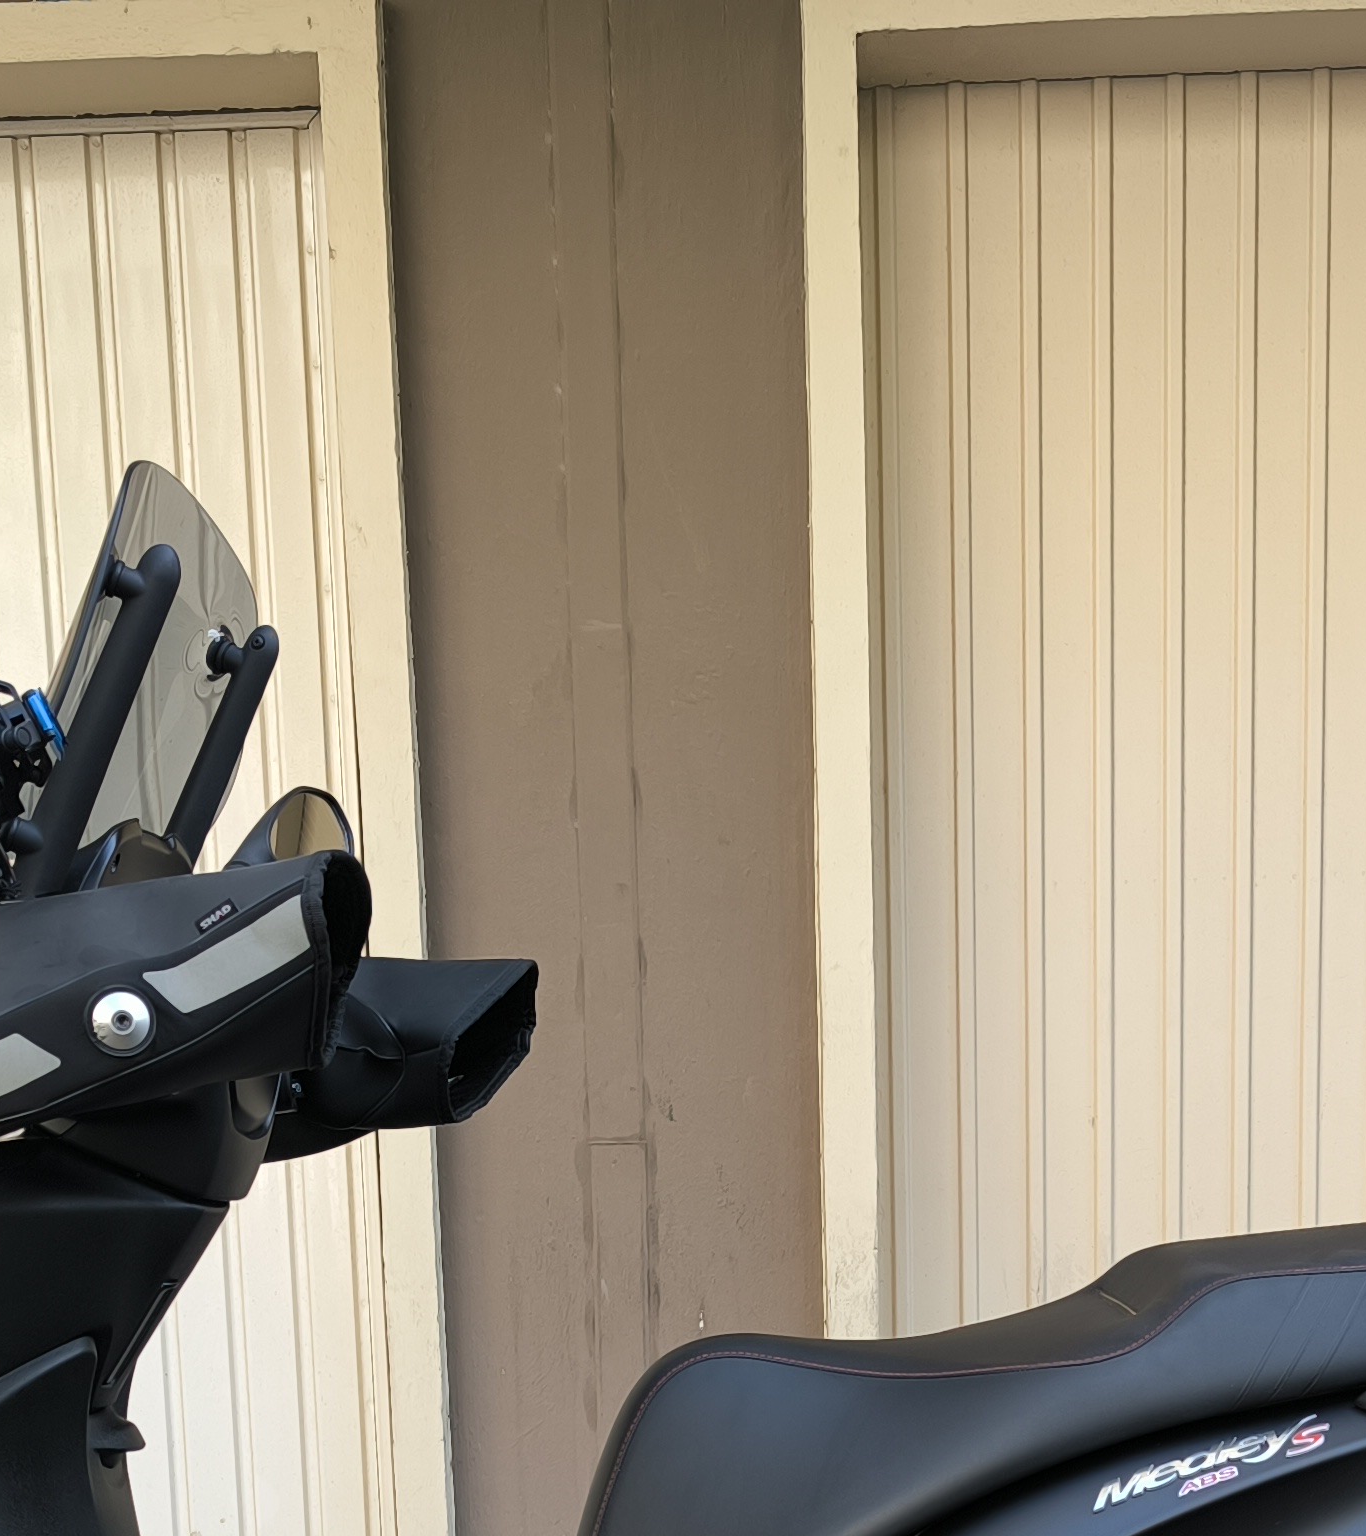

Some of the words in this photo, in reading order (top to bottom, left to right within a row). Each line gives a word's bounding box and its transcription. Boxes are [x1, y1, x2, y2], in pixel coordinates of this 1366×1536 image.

[199, 904, 232, 930] SHAD
[1285, 1422, 1331, 1458] S
[1178, 1465, 1239, 1497] ABS
